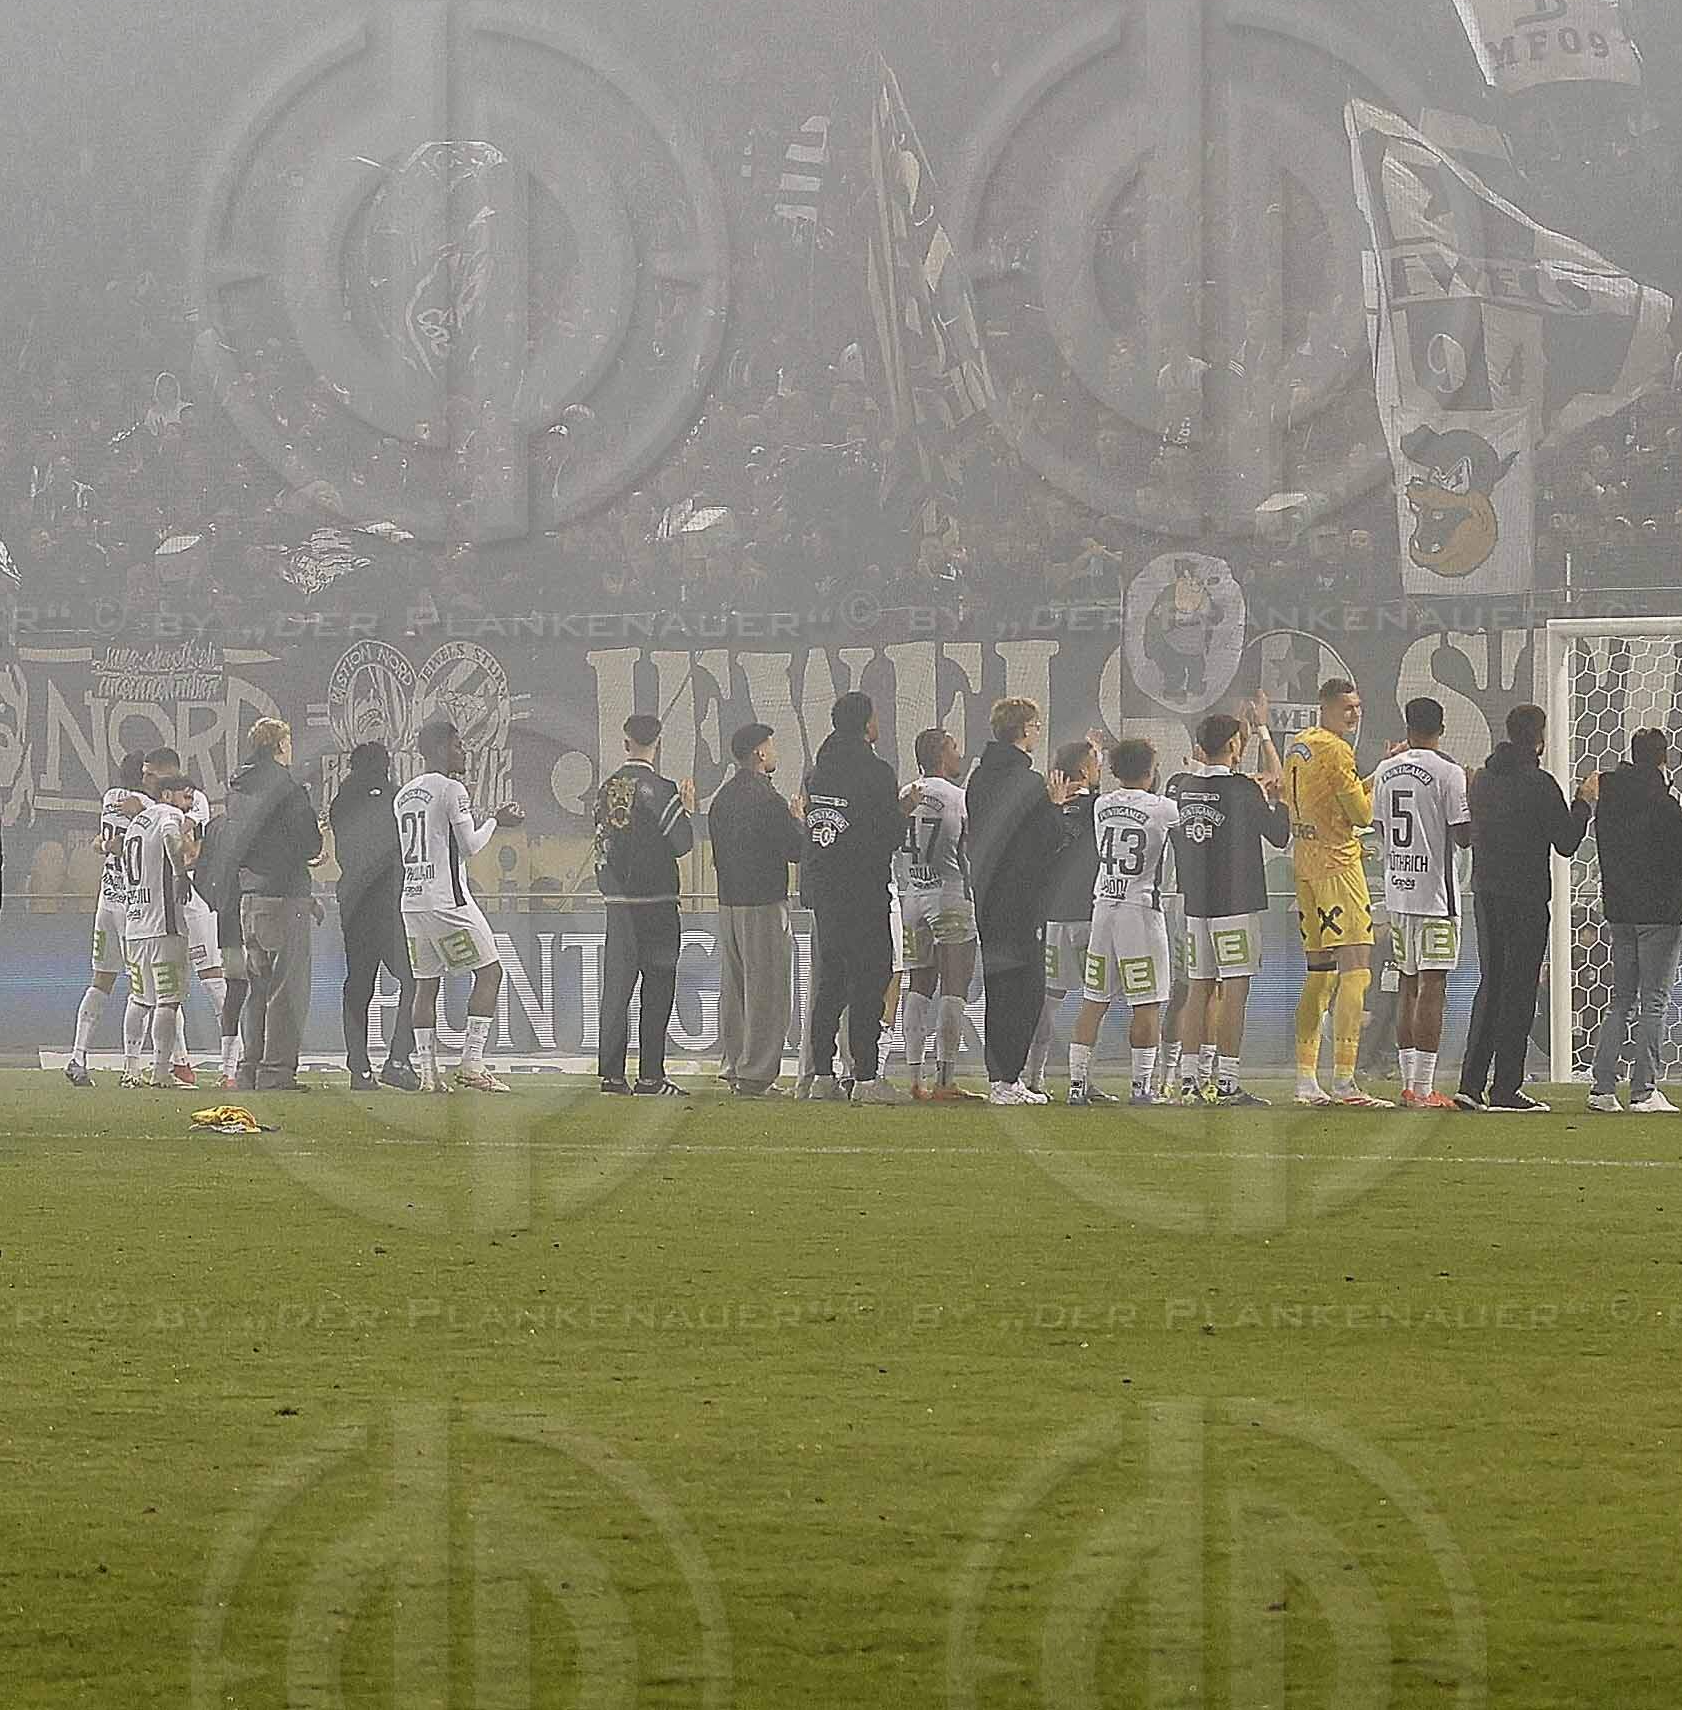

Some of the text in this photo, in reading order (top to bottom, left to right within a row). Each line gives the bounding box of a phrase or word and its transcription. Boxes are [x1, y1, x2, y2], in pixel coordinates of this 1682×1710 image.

[401, 810, 427, 865] 21
[1392, 790, 1414, 848] 5
[1100, 826, 1147, 875] 43
